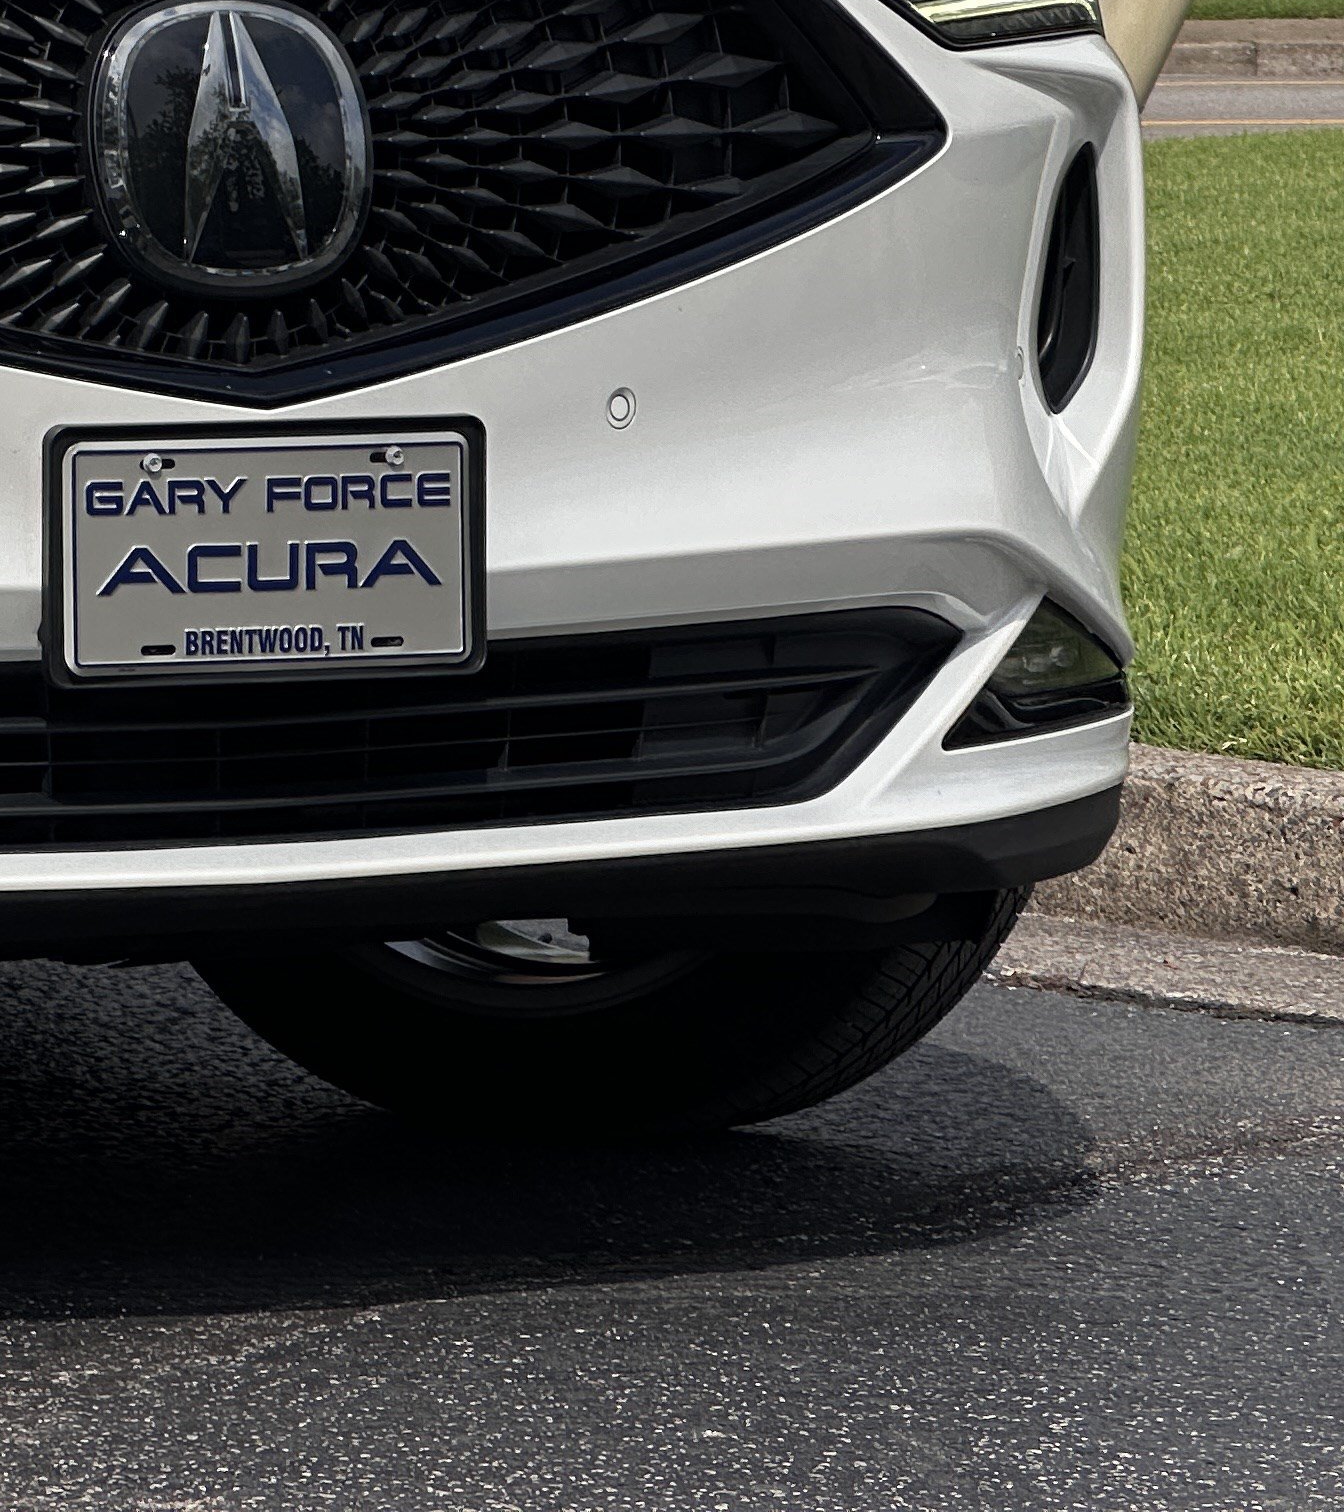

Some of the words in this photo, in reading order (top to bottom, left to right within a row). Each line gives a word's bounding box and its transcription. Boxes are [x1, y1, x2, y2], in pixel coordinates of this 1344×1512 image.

[84, 477, 248, 517] GARY
[265, 471, 452, 514] FORCE
[95, 538, 443, 597] ACURA
[183, 625, 330, 657] BRENTWOOD,
[337, 623, 365, 651] TN
